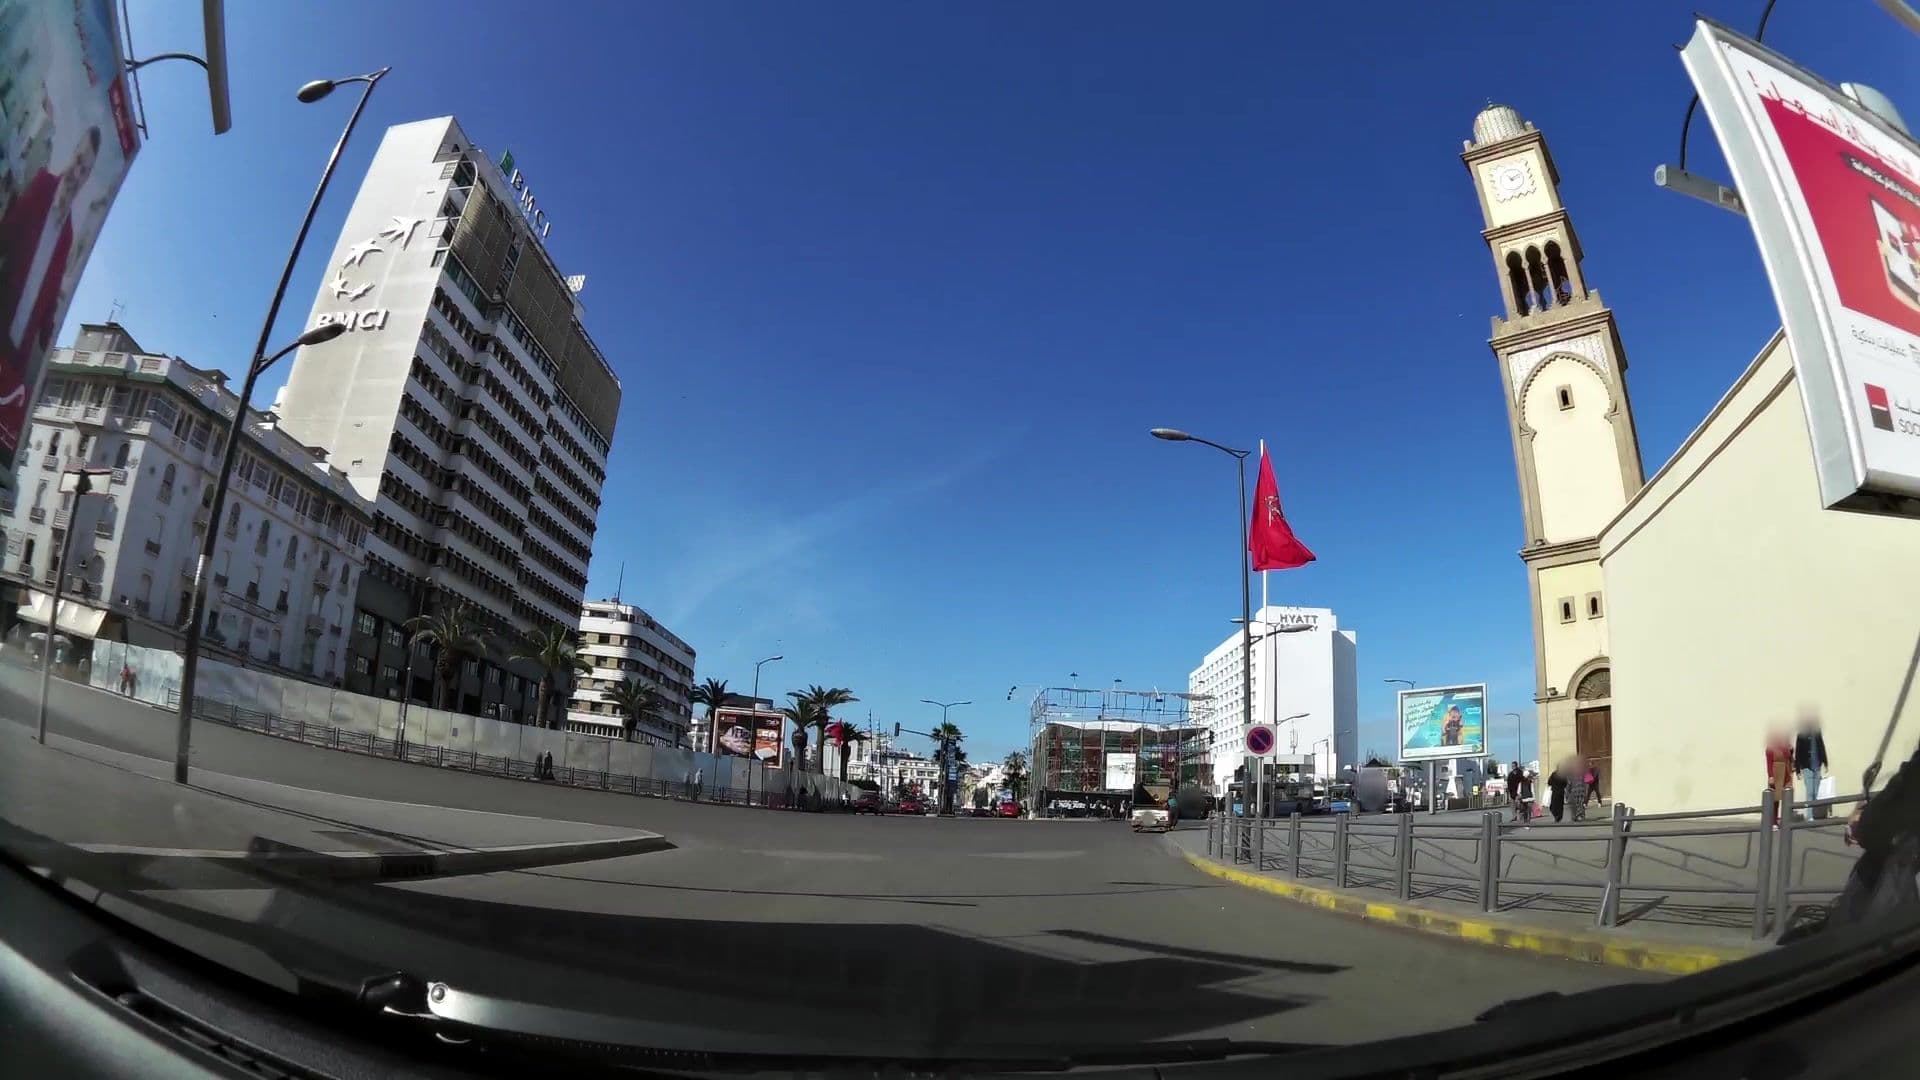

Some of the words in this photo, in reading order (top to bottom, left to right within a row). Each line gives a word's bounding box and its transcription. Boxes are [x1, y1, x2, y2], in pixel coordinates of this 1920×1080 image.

[511, 168, 551, 238] BMCI
[316, 308, 390, 332] BMCI
[1280, 613, 1319, 624] HYATT
